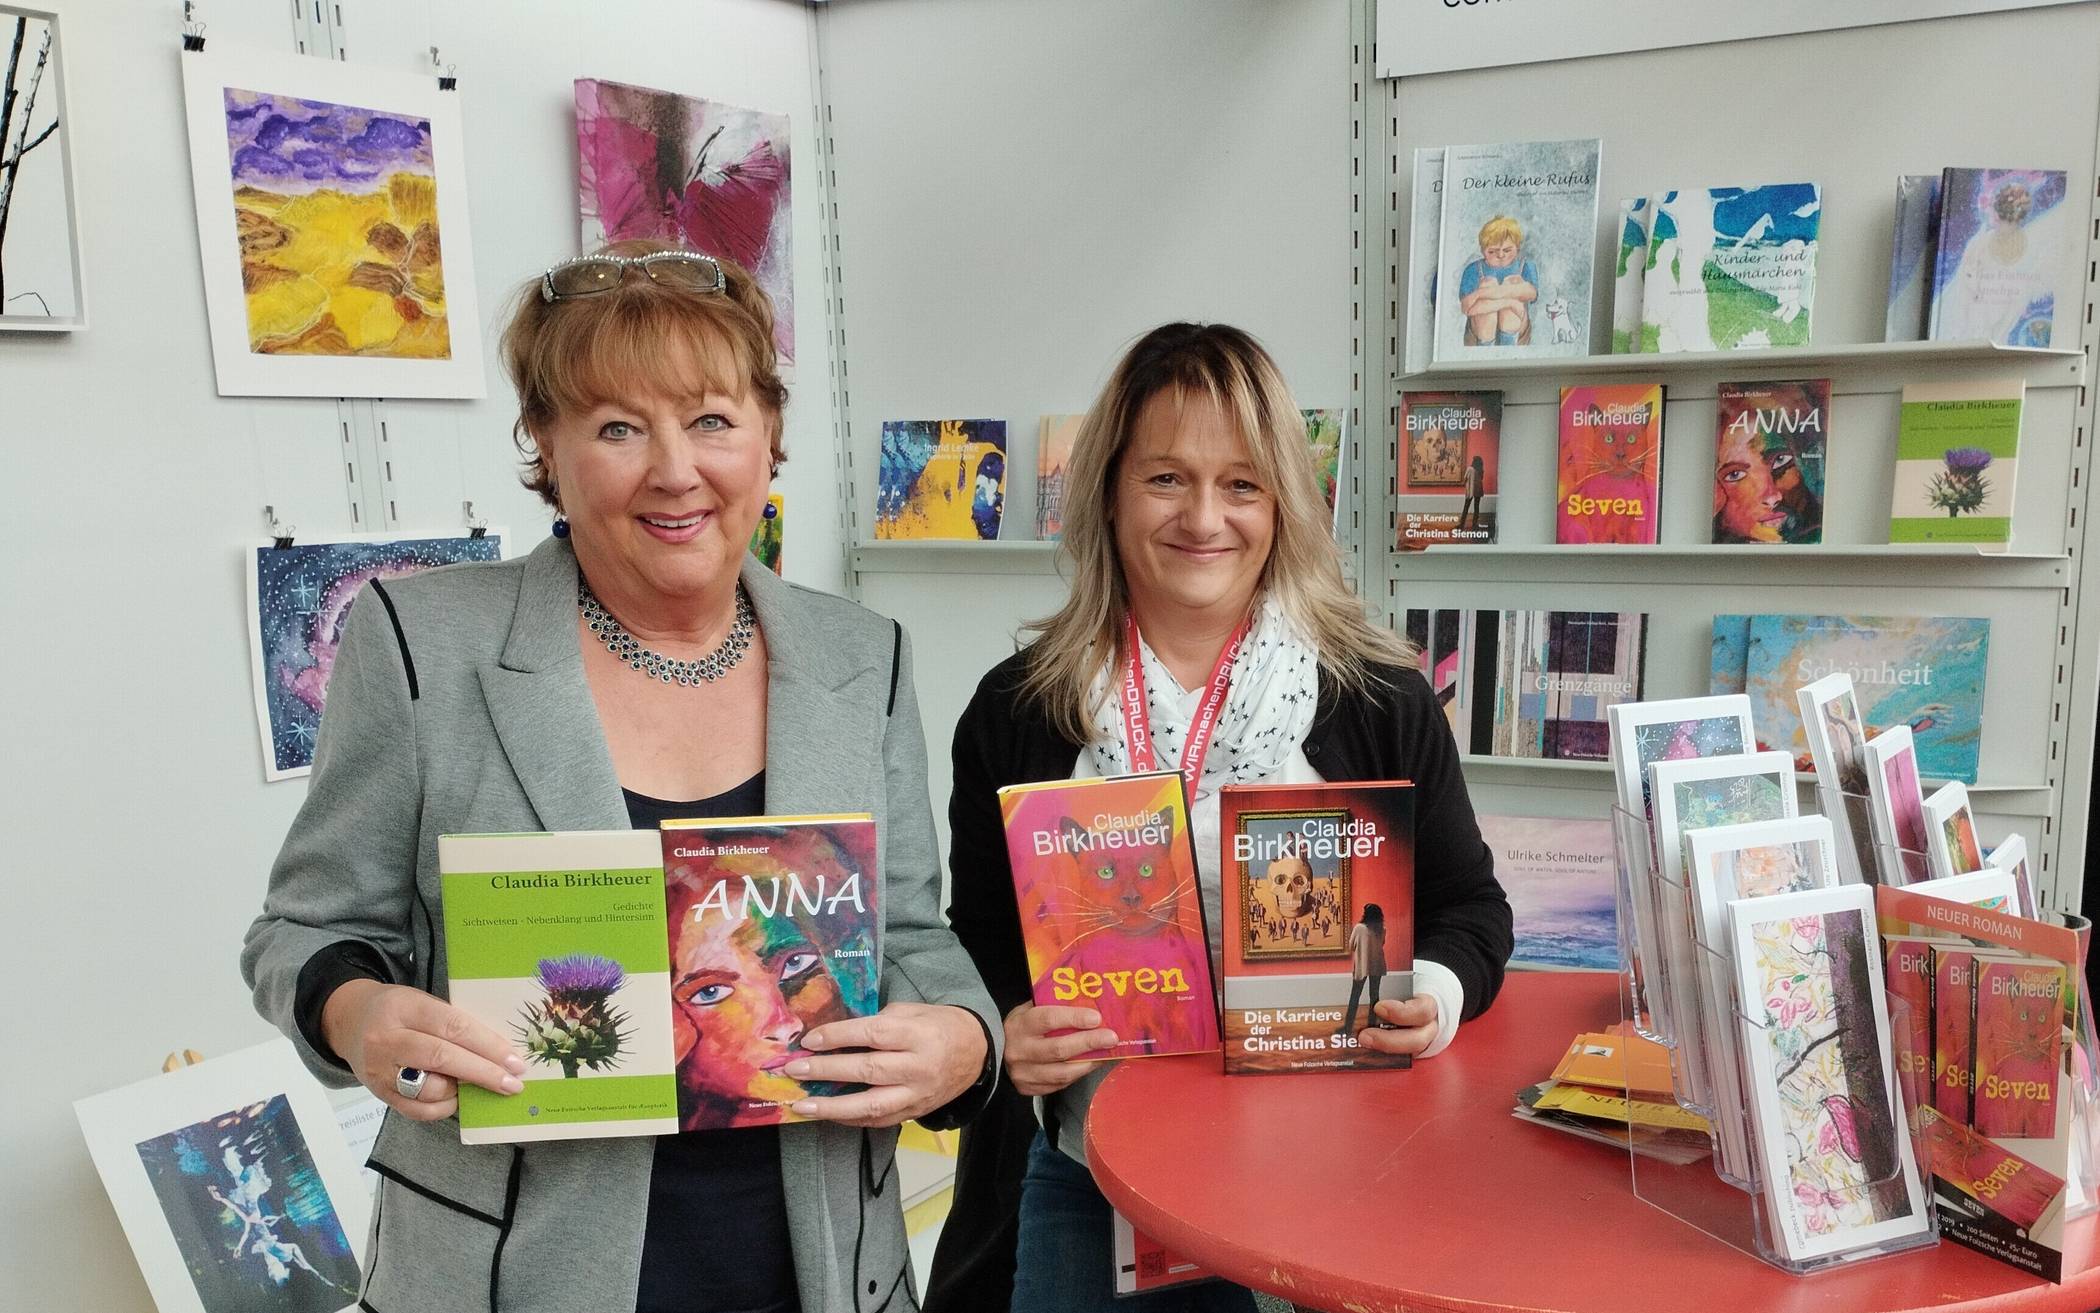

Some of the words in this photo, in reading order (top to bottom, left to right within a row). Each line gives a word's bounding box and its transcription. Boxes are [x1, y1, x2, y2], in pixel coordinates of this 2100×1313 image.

[1462, 177, 1491, 190] Der
[1494, 174, 1544, 188] kleine
[1546, 171, 1591, 188] Rufus
[1714, 251, 1770, 266] Kinder-
[1774, 249, 1806, 262] und
[1441, 408, 1482, 418] Claudia
[1607, 403, 1646, 414] Claudia
[1926, 402, 1964, 411] Claudia
[1966, 400, 2016, 410] Birkheuer
[1405, 415, 1486, 430] Birkheuer
[1572, 410, 1650, 427] Birkheuer
[1727, 406, 1821, 434] ANNA
[1567, 494, 1644, 516] Seven
[1406, 514, 1422, 522] Die
[1423, 514, 1459, 523] Karriere
[1405, 529, 1450, 538] Christina
[1452, 529, 1489, 539] Siemon
[1797, 658, 1933, 686] Schönheit
[1535, 675, 1632, 697] Grenzgänge
[1094, 810, 1161, 832] Claudia
[1302, 819, 1376, 837] Claudia
[1032, 823, 1170, 856] Birkheuer
[1233, 832, 1386, 862] Birkheuer
[673, 847, 715, 858] Claudia
[717, 845, 770, 856] Birkheuer
[1507, 850, 1542, 862] Ulrike
[1545, 851, 1605, 864] Schmelter
[491, 874, 560, 889] Claudia
[564, 872, 652, 887] Birkheuer
[691, 872, 866, 922] ANNA
[613, 902, 655, 911] Gedichte
[462, 917, 518, 927] Sichtweisen
[527, 915, 582, 926] Nebenklang
[585, 914, 602, 923] und
[605, 913, 656, 923] Hintersinn
[1927, 905, 1969, 927] NEUER
[1973, 916, 2022, 940] ROMAN
[834, 948, 871, 958] Roman
[1052, 967, 1190, 1000] Seven
[2023, 969, 2059, 983] Claudia
[1991, 975, 2061, 998] Birkheuer
[1244, 1010, 1271, 1024] Die
[1275, 1009, 1342, 1022] Karriere
[1250, 1024, 1271, 1035] der
[1243, 1036, 1326, 1051] Christina
[1330, 1034, 1362, 1048] Sie
[1985, 1074, 2050, 1100] Seven
[339, 1111, 374, 1130] reisliste
[1971, 1158, 2024, 1200] Seven
[1963, 1197, 1985, 1217] SEVEN
[1951, 1228, 1968, 1241] Neue
[1996, 1246, 2042, 1271] Verlagsanstalt
[1979, 1229, 1999, 1243] Seiten
[2021, 1246, 2038, 1259] Euro
